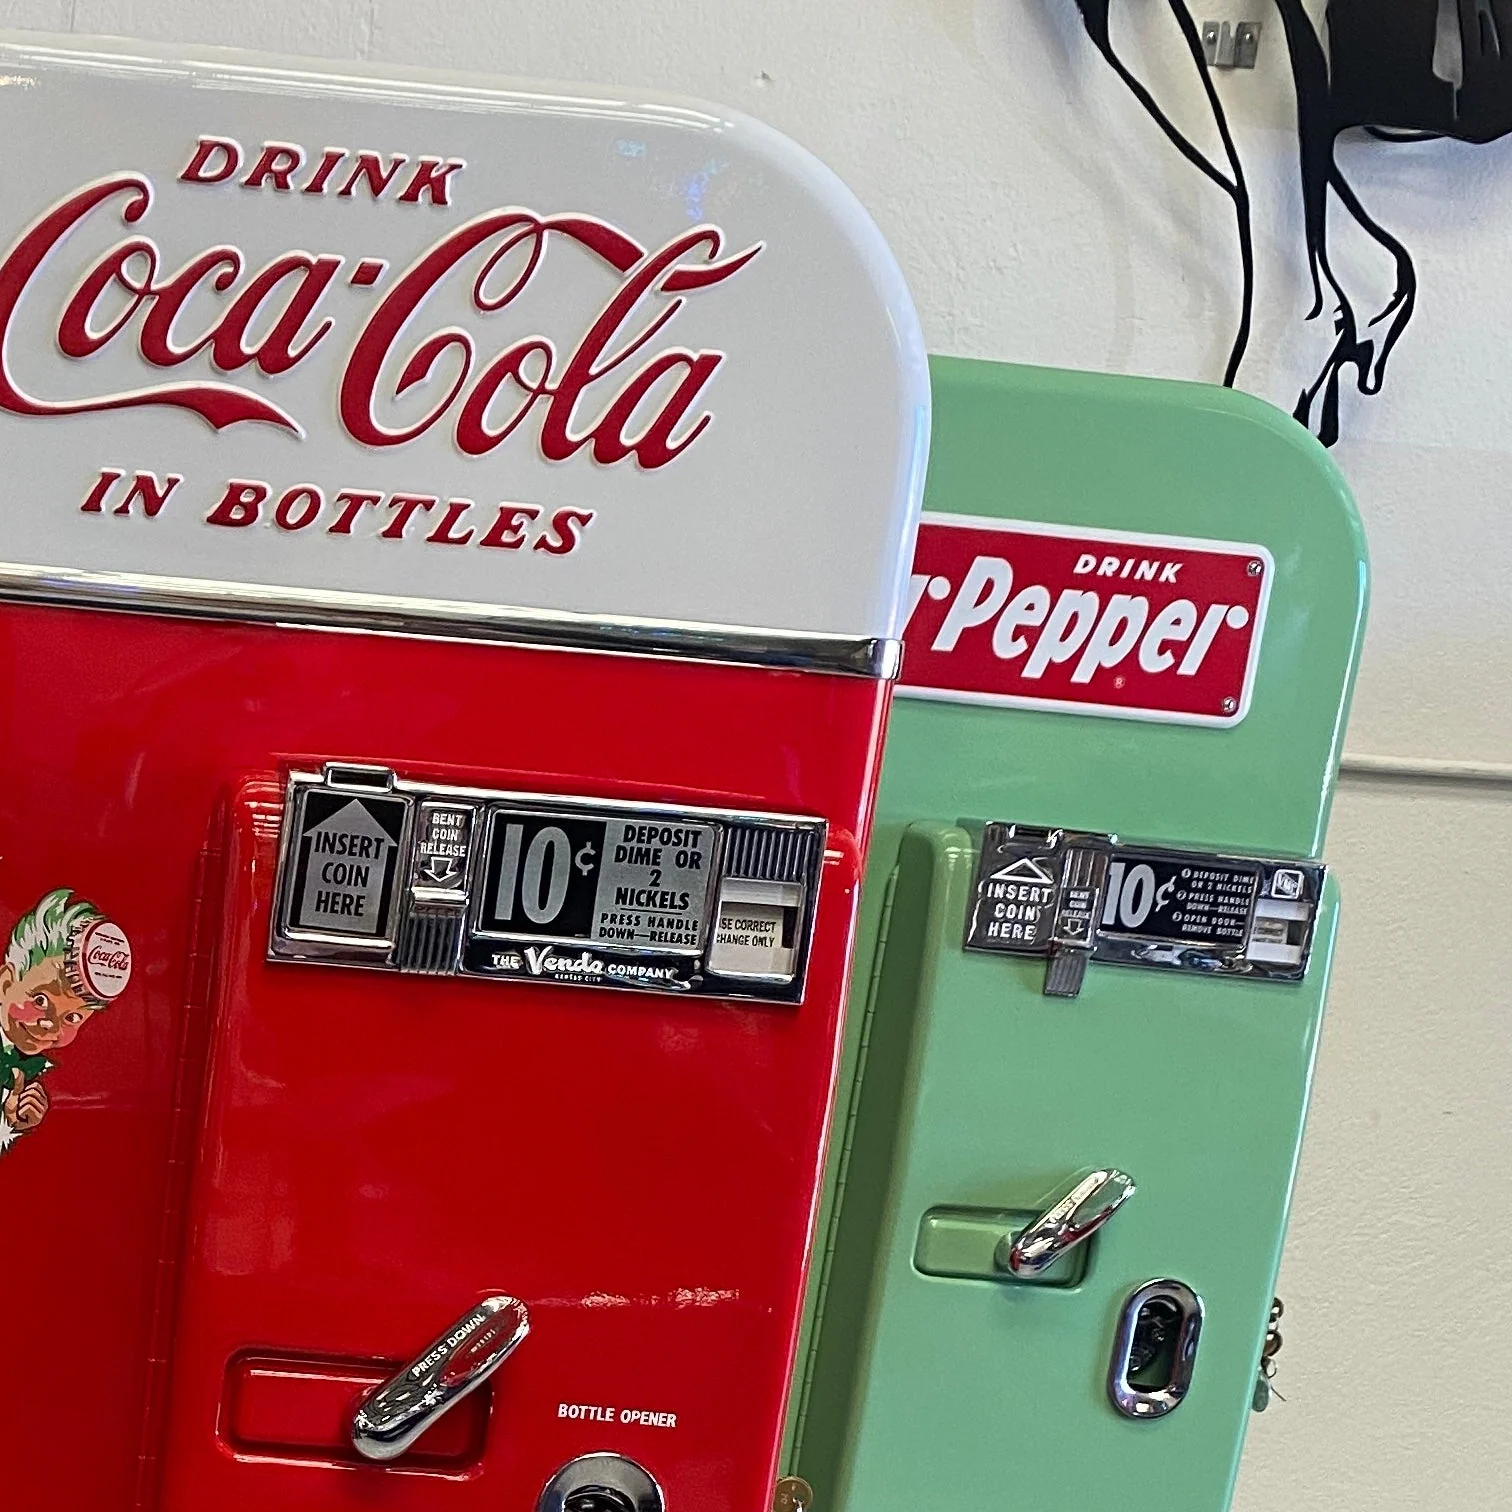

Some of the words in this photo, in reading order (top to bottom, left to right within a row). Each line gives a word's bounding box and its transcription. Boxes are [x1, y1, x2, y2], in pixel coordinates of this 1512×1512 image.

[179, 136, 464, 206] DRINK
[81, 470, 182, 517] IN
[206, 479, 596, 556] BOTTLES
[1073, 553, 1184, 584] DRINK
[931, 554, 1249, 684] Pepper
[431, 813, 463, 826] BENT
[431, 827, 458, 841] COIN
[623, 824, 702, 848] DEPOSIT
[314, 831, 385, 860] INSERT
[420, 842, 467, 857] RELEASE
[614, 845, 663, 866] DIME
[675, 850, 702, 869] OR
[321, 861, 370, 888] COIN
[649, 869, 662, 887] 2
[1193, 871, 1229, 881] DEPOSIT
[1233, 875, 1254, 884] DIME
[987, 882, 1053, 902] INSERT
[1191, 880, 1203, 888] OR
[1208, 881, 1213, 890] 2
[1216, 883, 1252, 893] NICKELS
[315, 890, 366, 917] HERE
[615, 887, 690, 910] NICKELS
[1188, 892, 1214, 902] PRESS
[1217, 896, 1250, 905] HANDLE
[994, 903, 1037, 921] COIN
[1184, 914, 1207, 923] OPEN
[600, 913, 641, 926] PRESS
[648, 916, 698, 931] HANDLE
[719, 918, 733, 930] SE
[735, 920, 777, 933] CORRECT
[988, 921, 1036, 940] HERE
[1182, 924, 1212, 934] REMOVE
[1216, 927, 1243, 937] BOTTLE
[752, 935, 775, 947] ONLY
[491, 953, 521, 969] THE
[523, 946, 605, 975] Vendo
[607, 963, 674, 979] COMPANY
[411, 1343, 448, 1377] PRESS
[447, 1314, 487, 1347] DOWN
[557, 1403, 615, 1422] BOTTLE
[620, 1409, 677, 1428] OPENER
